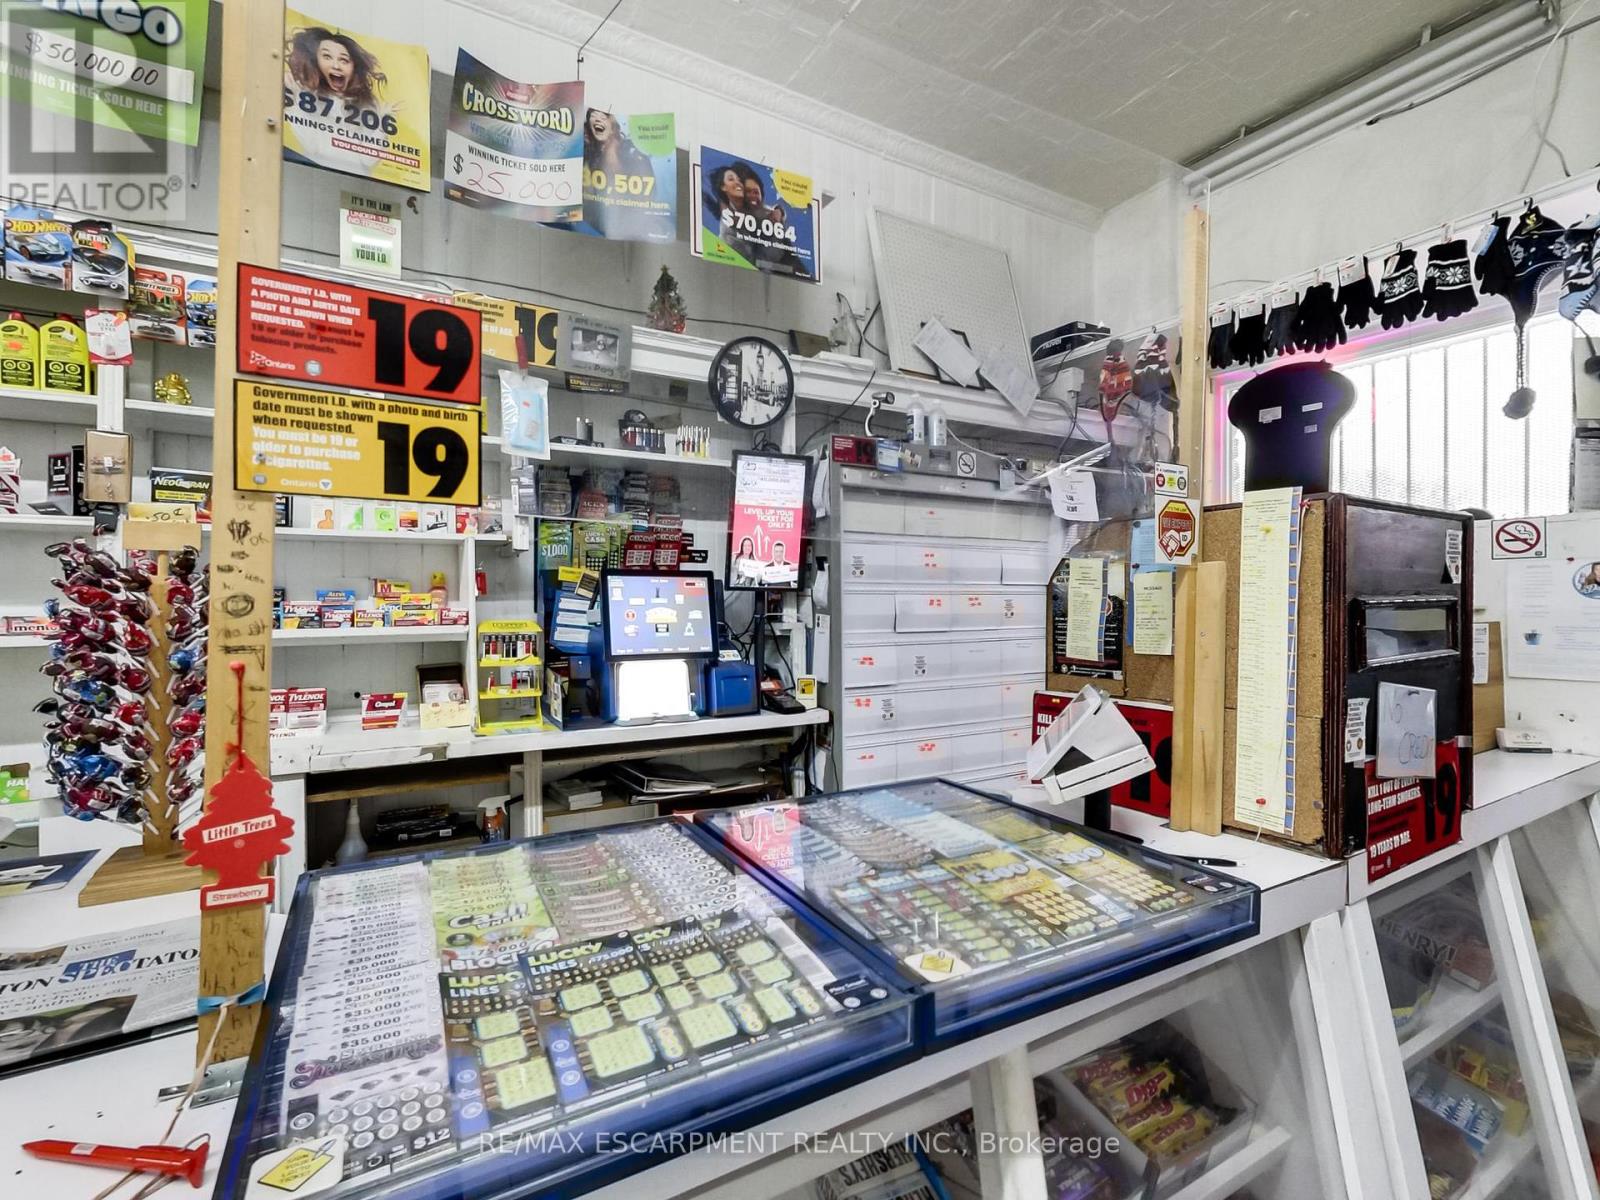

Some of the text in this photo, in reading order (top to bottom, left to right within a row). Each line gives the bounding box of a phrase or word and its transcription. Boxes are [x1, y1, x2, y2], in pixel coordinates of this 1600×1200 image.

[104, 92, 133, 110] SOLD
[136, 99, 164, 117] HERE
[462, 81, 574, 135] CROSSWORD
[333, 139, 351, 149] YOU
[351, 143, 378, 157] COULD
[337, 128, 391, 149] CLAIMED
[392, 142, 421, 157] HERE
[453, 153, 465, 176] $
[468, 145, 566, 173] WINNING TICKET SOLD HERE
[351, 195, 364, 207] IT'S
[366, 199, 377, 209] THE
[13, 219, 37, 234] HOT
[721, 207, 797, 242] $70,064
[744, 233, 772, 248] winnings
[772, 241, 797, 253] claimed
[356, 248, 376, 262] YOUR
[251, 275, 313, 296] GOVERNMENT
[330, 289, 352, 303] WITH
[251, 287, 361, 317] A PHOTO AND BIRTH DATE
[251, 299, 353, 326] MUST BE SHOWN WHEN
[251, 311, 306, 329] REQUESTED.
[367, 296, 474, 393] 19
[252, 386, 469, 422] Government I.D. with a photo and birth
[252, 400, 374, 424] date must be shown
[252, 413, 355, 436] when requested.
[252, 426, 359, 448] You must be 19 or
[252, 440, 361, 462] older to purchase
[377, 420, 470, 500] 19
[280, 477, 319, 489] Ontario
[152, 511, 172, 522] 50
[757, 514, 780, 523] TICKET
[541, 544, 569, 557] $1,000
[584, 536, 606, 544] CASH
[283, 604, 319, 614] TYLENOL
[356, 611, 385, 620] TYLENOL
[288, 692, 326, 702] TYLENOL
[1037, 713, 1052, 725] KILL
[1367, 784, 1380, 800] KILL
[207, 817, 273, 843] Little Trees
[211, 887, 265, 903] Strawberry
[1379, 917, 1458, 967] HENRY!
[528, 941, 603, 966] LUCKY
[530, 957, 578, 976] LINES
[449, 983, 500, 998] LINES
[413, 1127, 450, 1150] $12
